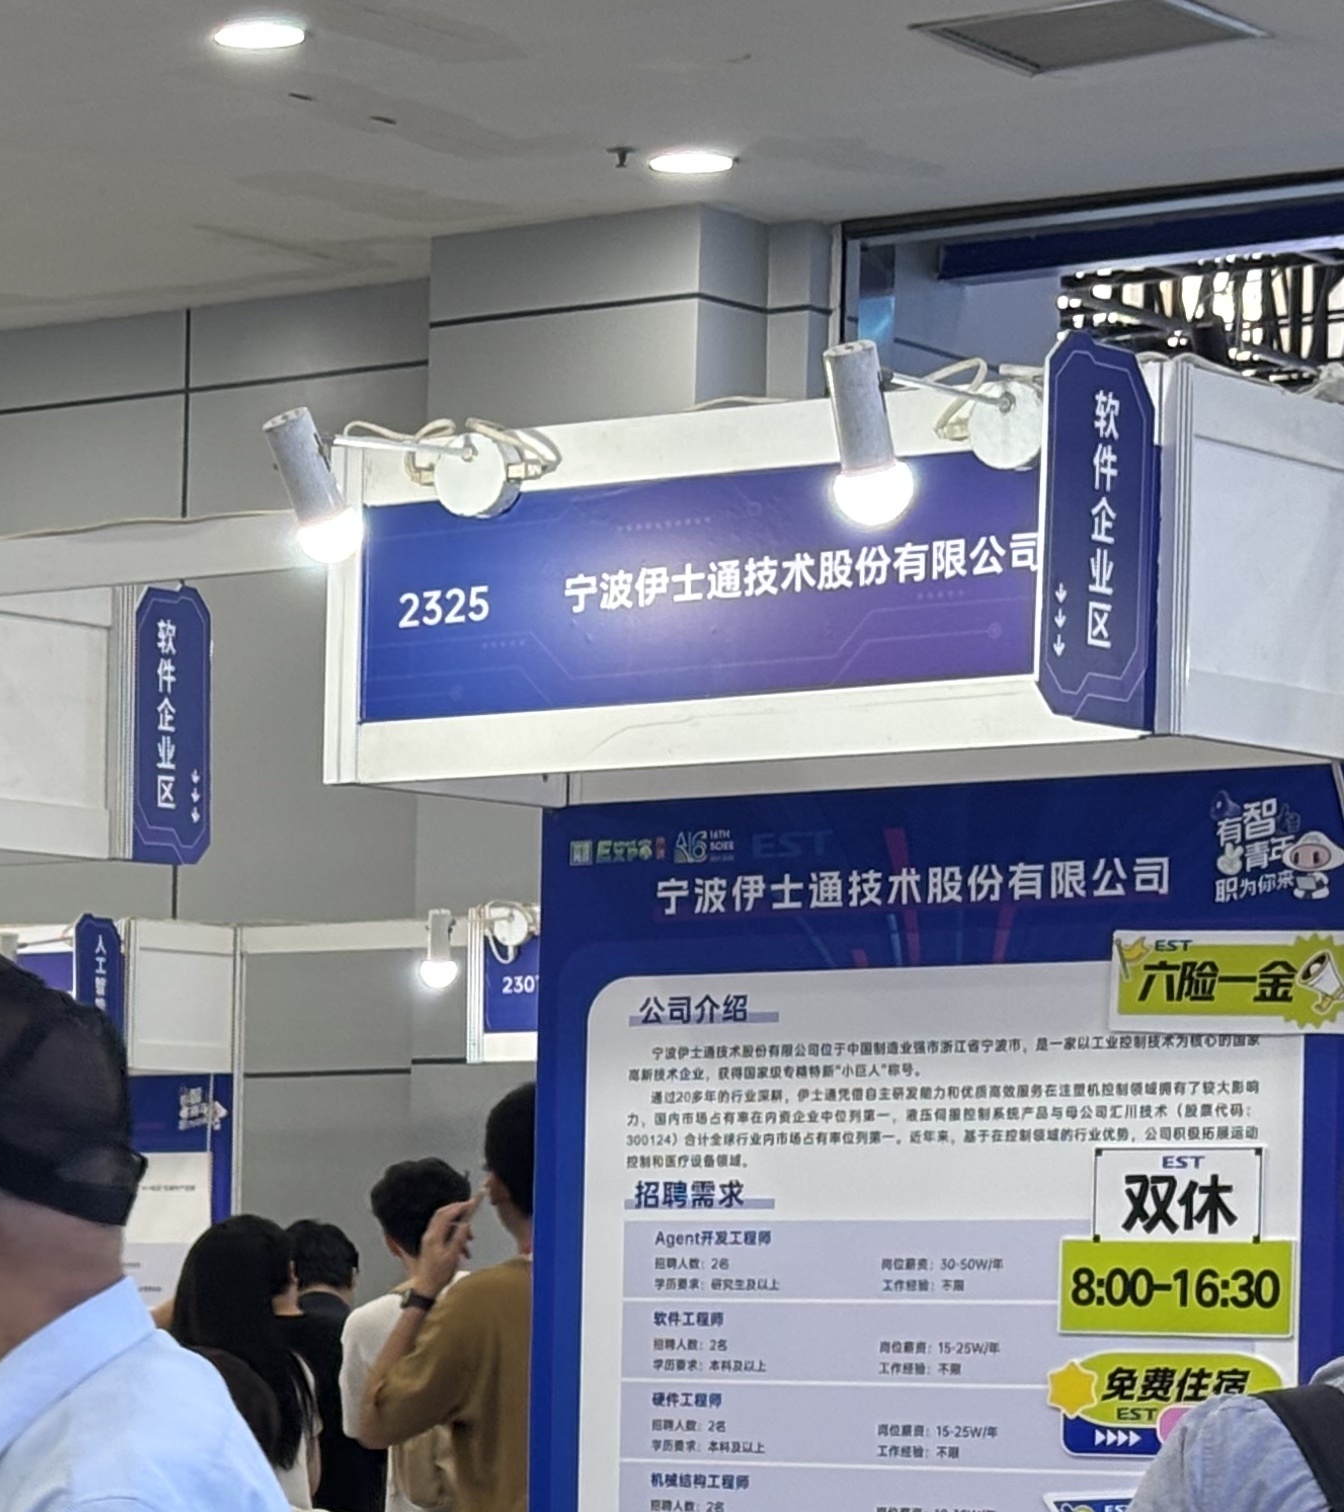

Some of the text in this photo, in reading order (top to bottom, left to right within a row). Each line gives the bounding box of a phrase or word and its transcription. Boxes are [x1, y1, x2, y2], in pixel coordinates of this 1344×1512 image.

[1088, 389, 1120, 649] 软件企业区
[564, 530, 1041, 614] 宁波伊士通技术股份有限公司
[398, 585, 491, 631] 2325
[156, 618, 177, 809] 软件企业区
[1215, 797, 1278, 848] 有智
[655, 856, 1171, 917] 宁波伊士通技术股份有限公司
[1215, 870, 1296, 904] 职为你来
[1153, 939, 1194, 952] EST
[1137, 960, 1299, 1003] 六险一金
[638, 994, 750, 1025] 公司介绍
[626, 1153, 749, 1170] 控制和医疗设备领域。
[1161, 1155, 1206, 1170] EST
[633, 1180, 746, 1211] 招聘需求
[1121, 1173, 1239, 1235] 双休
[654, 1230, 772, 1248] Agent开发工程师
[1070, 1266, 1282, 1310] 8:00-16:30
[653, 1311, 724, 1327] 软件工程师
[652, 1391, 723, 1408] 硬件工程师
[1101, 1366, 1251, 1403] 免费住宿
[1116, 1407, 1158, 1421] EST
[650, 1472, 750, 1490] 机械结构工程师
